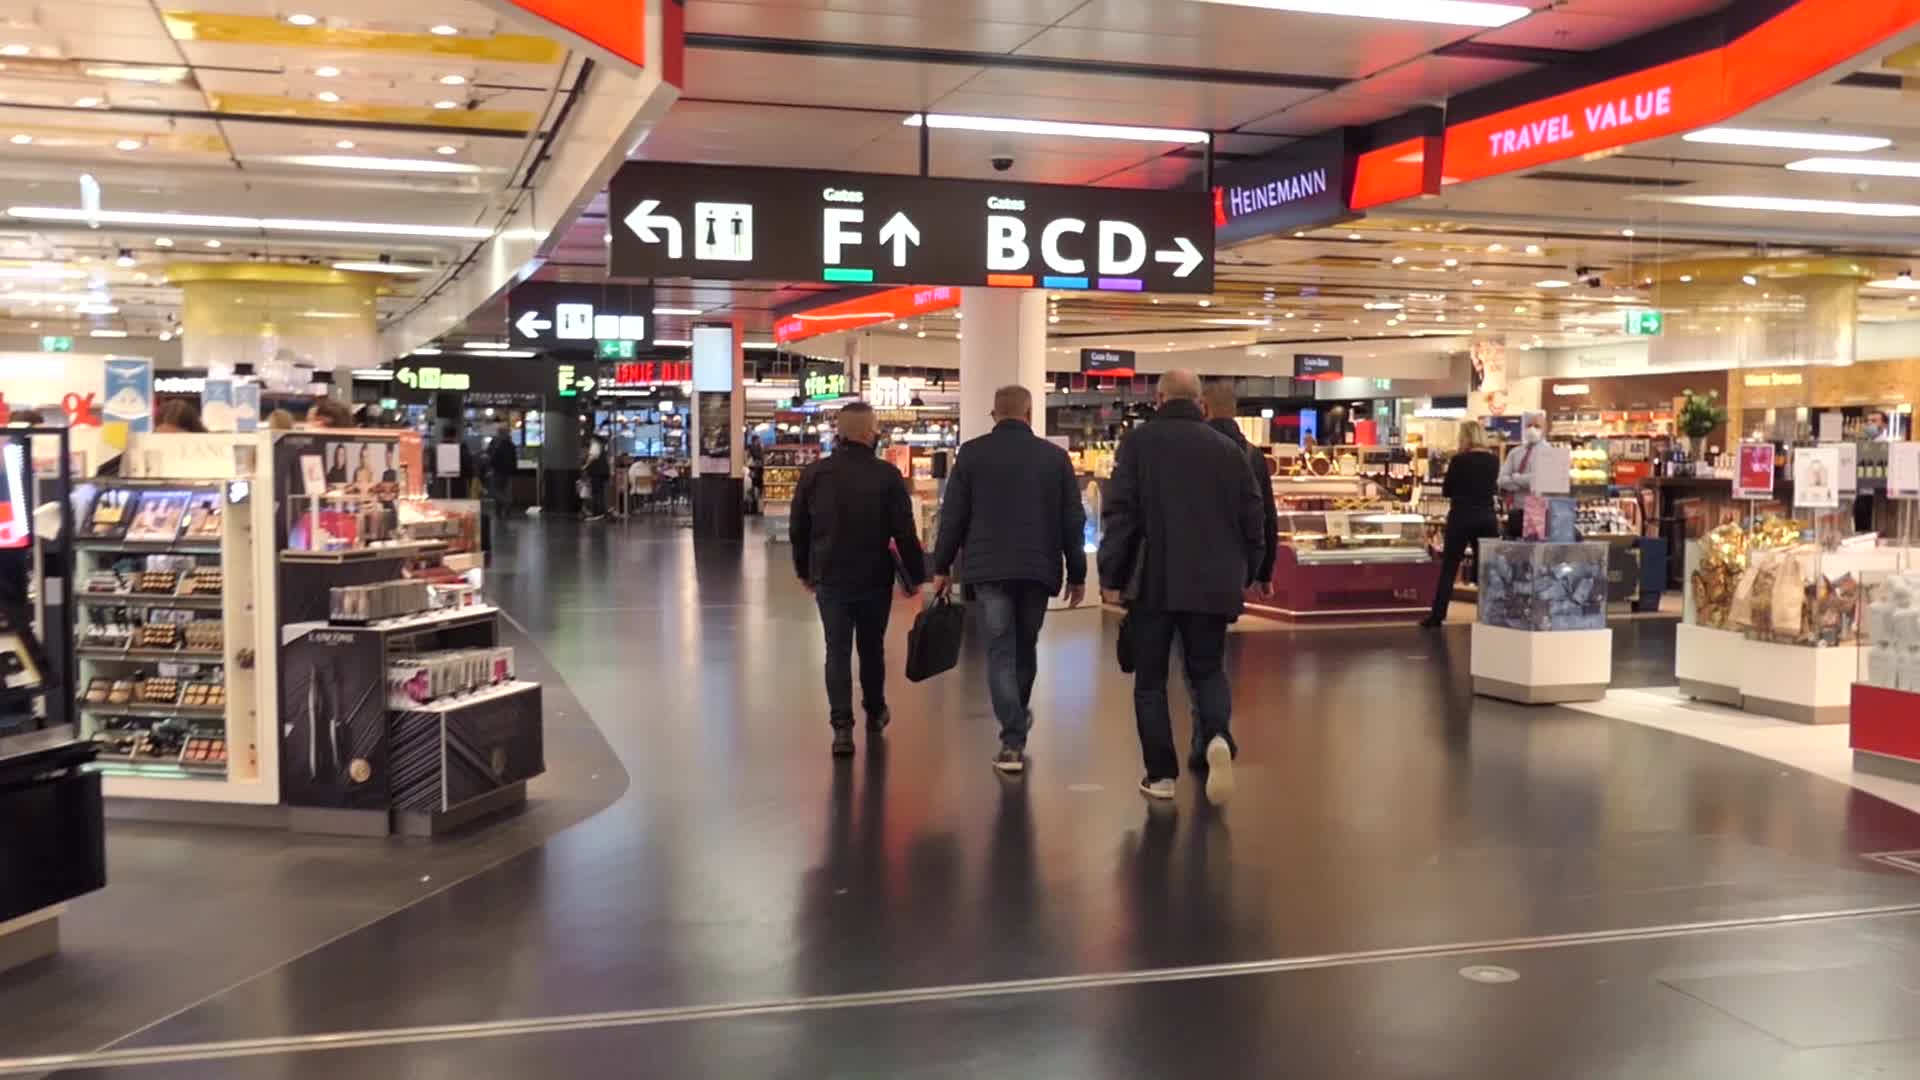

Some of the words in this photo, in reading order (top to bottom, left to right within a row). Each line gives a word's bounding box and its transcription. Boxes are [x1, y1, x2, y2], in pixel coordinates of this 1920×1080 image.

[1489, 114, 1574, 157] TRAVEL
[1584, 86, 1671, 133] VALUE
[823, 188, 864, 203] Gates
[987, 196, 1026, 211] Gates
[1230, 167, 1327, 217] HEINEMANN
[823, 207, 864, 264] F
[986, 215, 1031, 271] B
[1041, 217, 1087, 274] C
[1098, 219, 1147, 275] D
